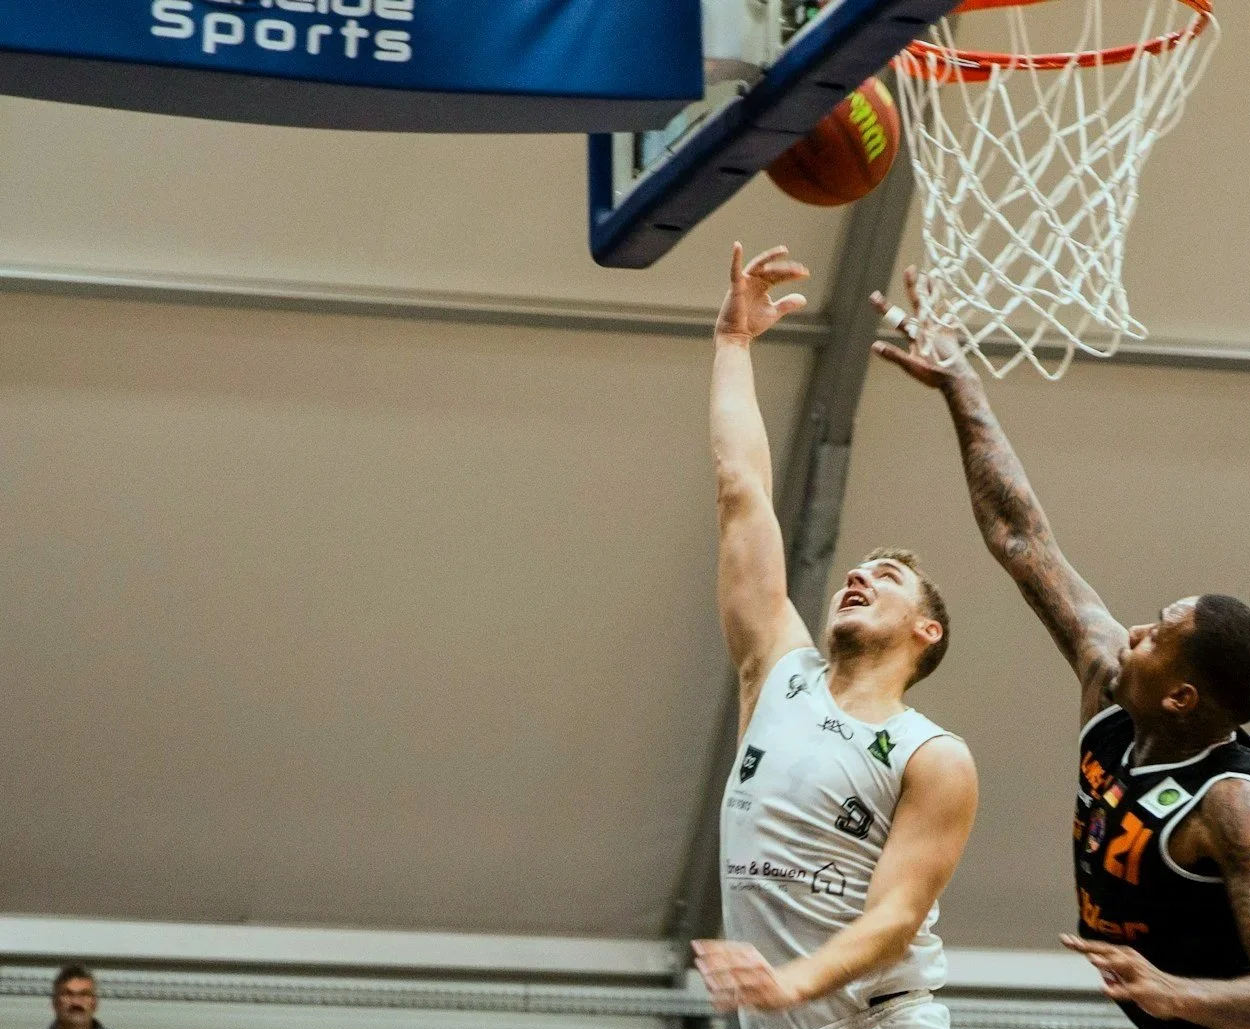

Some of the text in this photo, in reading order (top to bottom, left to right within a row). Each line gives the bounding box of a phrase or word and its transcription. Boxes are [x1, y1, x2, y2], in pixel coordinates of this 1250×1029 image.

[749, 861, 759, 876] &
[762, 862, 807, 878] Bauen
[1104, 812, 1154, 886] 21
